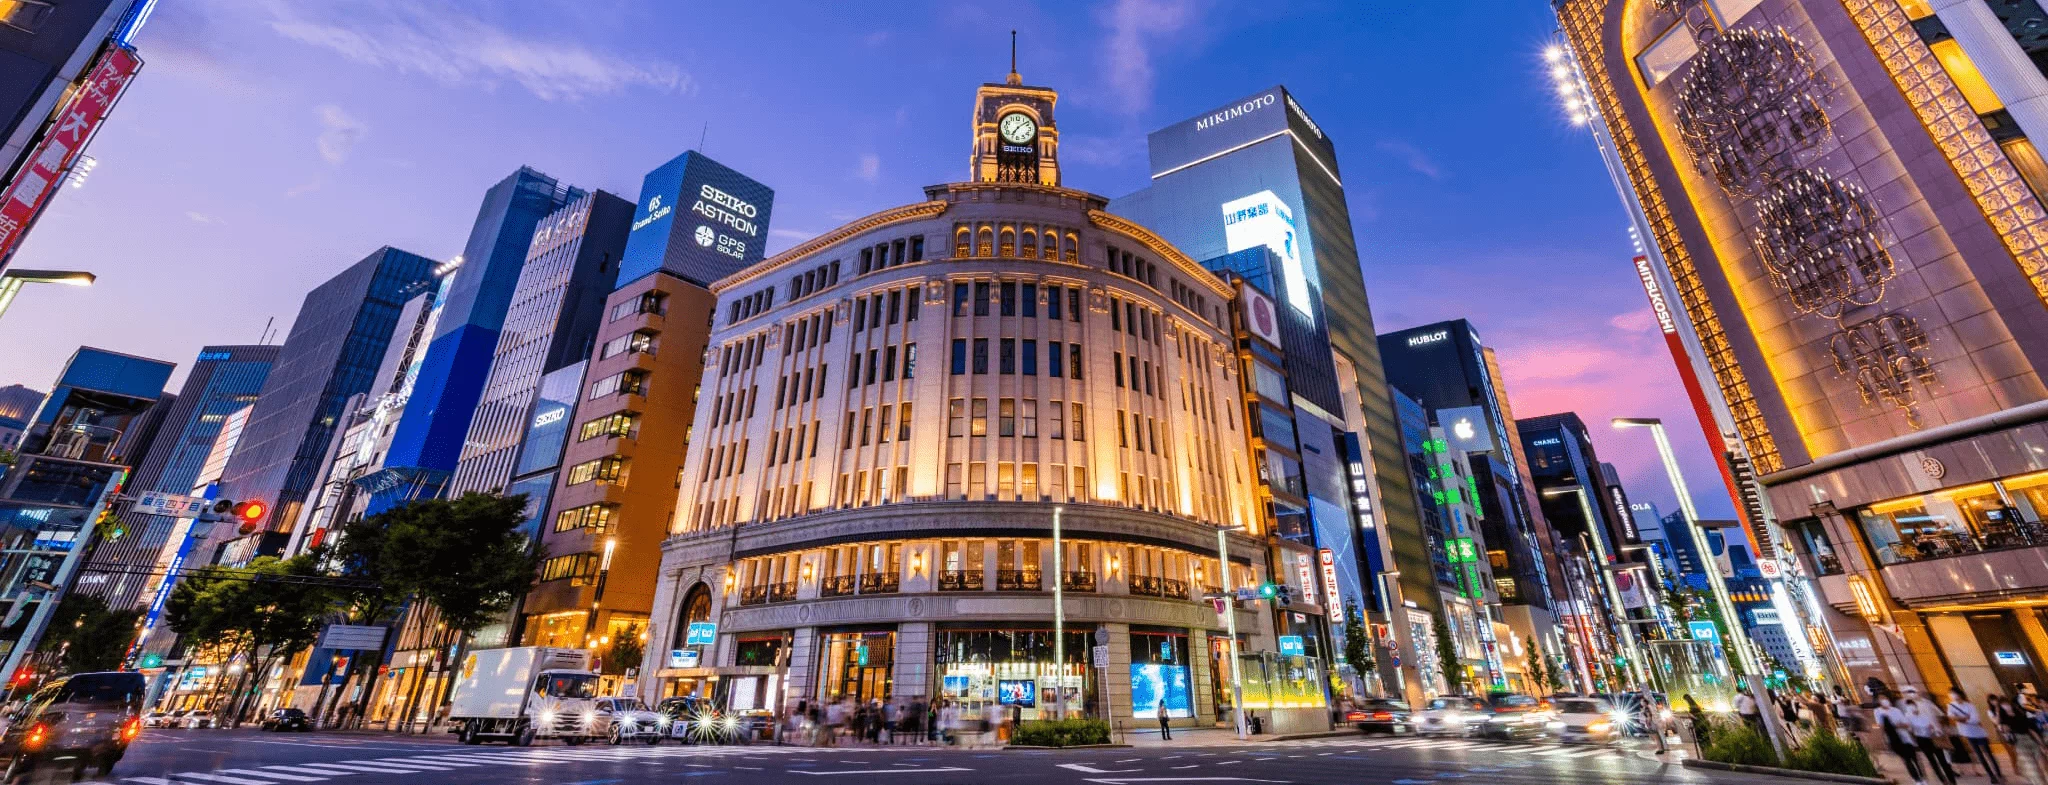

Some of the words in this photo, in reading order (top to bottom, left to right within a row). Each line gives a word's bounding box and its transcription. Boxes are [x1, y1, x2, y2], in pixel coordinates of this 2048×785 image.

[1196, 94, 1275, 131] MIKIMOTO
[1003, 145, 1033, 153] SEIKO
[701, 184, 757, 218] SEIKO
[632, 216, 652, 232] Grand
[652, 205, 671, 221] Seiko
[692, 200, 757, 237] ASTRON
[1225, 203, 1269, 226] 山野楽器
[717, 244, 744, 261] SOLAR
[718, 234, 746, 253] GPS
[1636, 260, 1676, 334] MITSUKOSHI
[1408, 331, 1448, 346] HUBLOT
[534, 407, 565, 428] SEIKO
[1533, 437, 1561, 447] CHANEL
[1629, 502, 1652, 511] OLA
